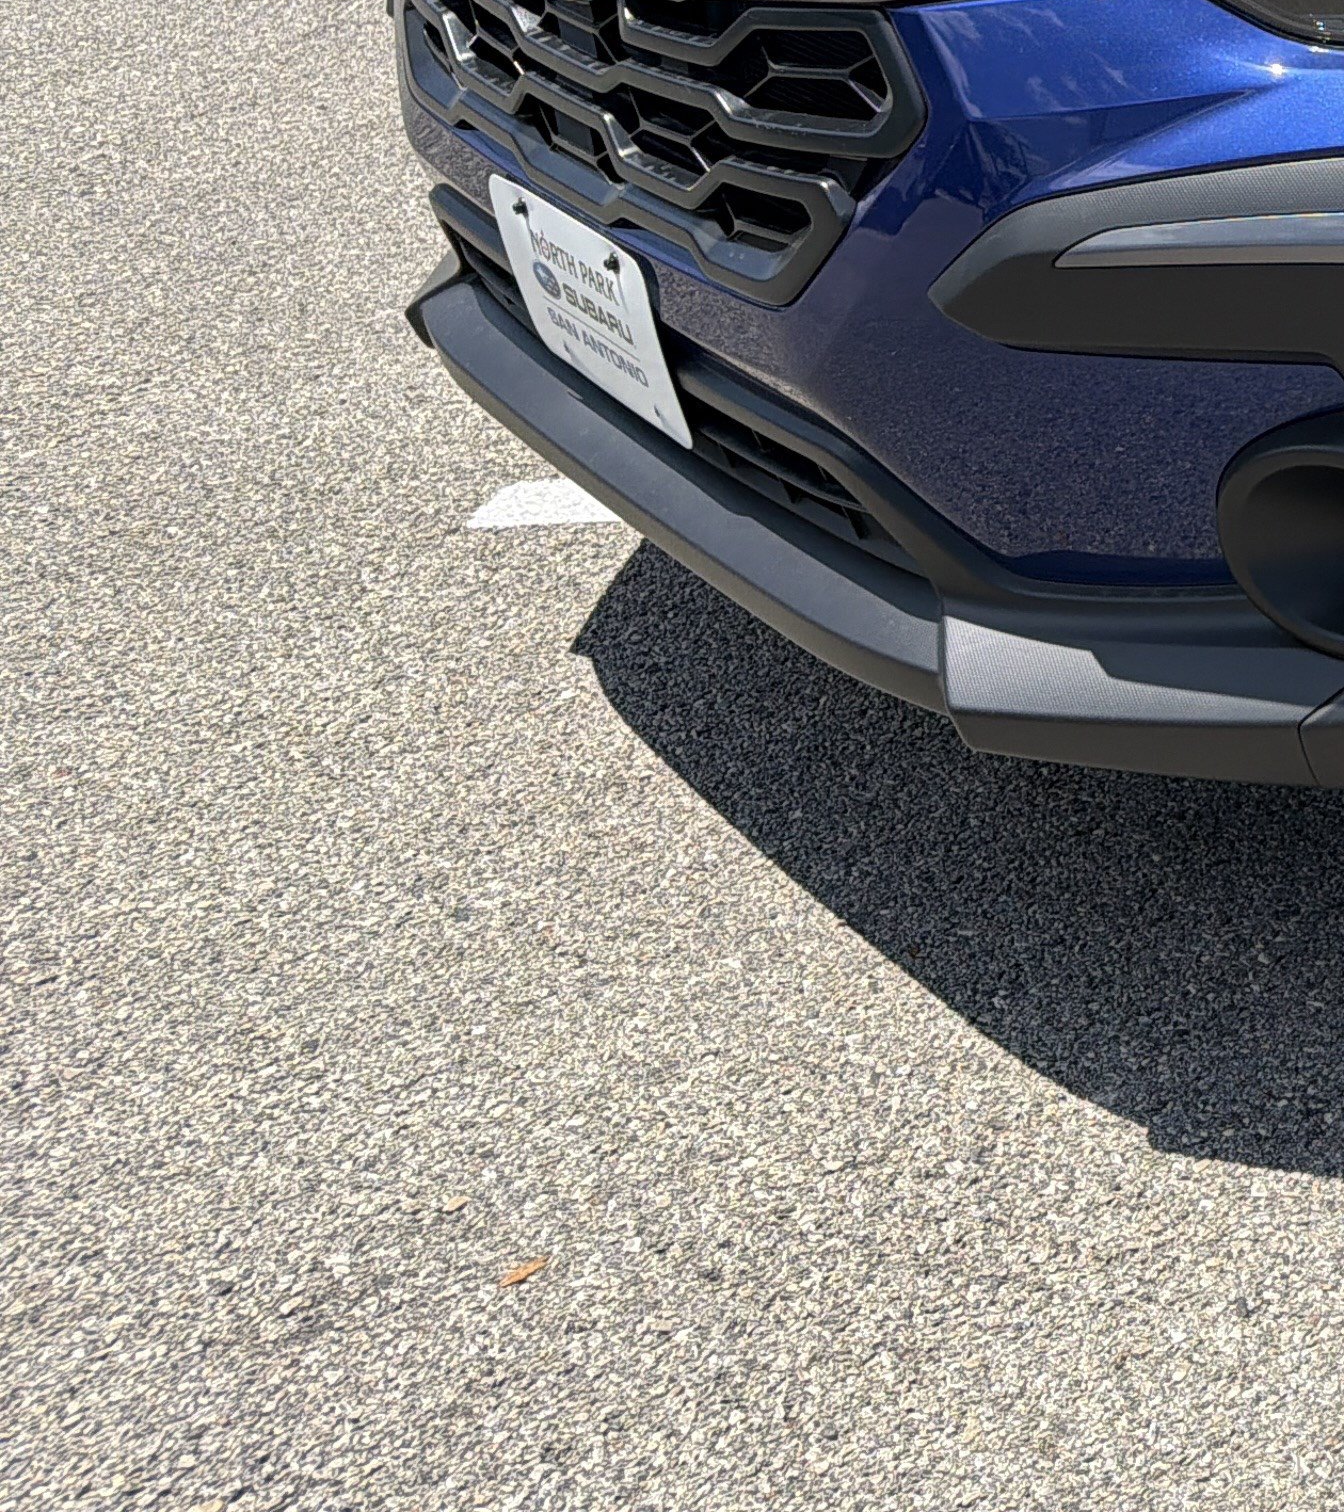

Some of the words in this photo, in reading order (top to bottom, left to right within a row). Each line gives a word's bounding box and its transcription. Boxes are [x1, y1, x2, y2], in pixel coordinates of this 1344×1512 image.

[530, 229, 579, 279] NORTH
[578, 258, 622, 307] PARK
[547, 306, 580, 342] SAN
[582, 331, 649, 388] ANTONIO
[562, 282, 634, 346] SUBARU
